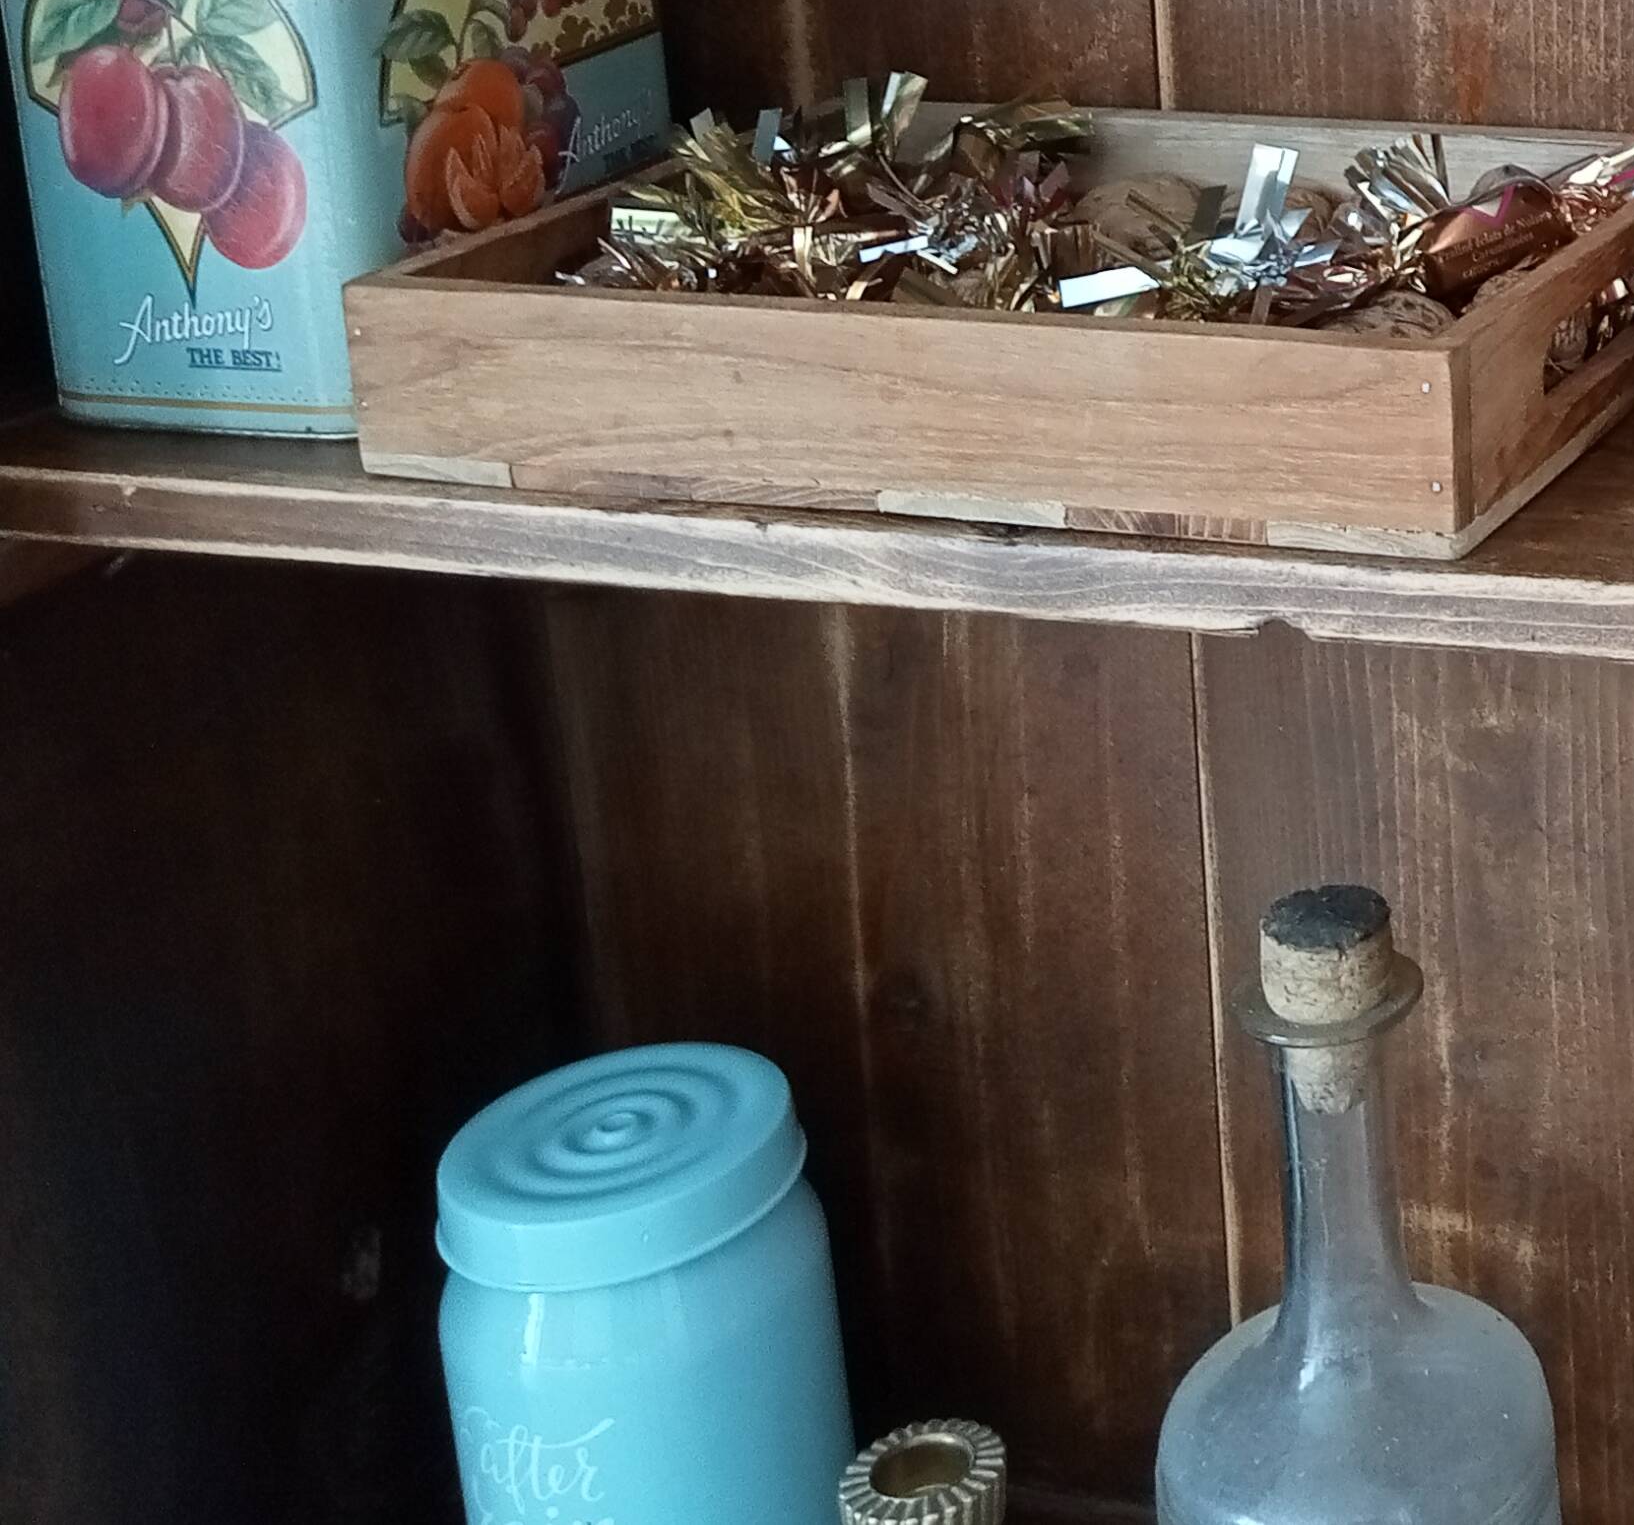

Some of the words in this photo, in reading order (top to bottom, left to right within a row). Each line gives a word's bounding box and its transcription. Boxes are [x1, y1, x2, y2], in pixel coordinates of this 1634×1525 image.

[113, 292, 273, 365] Anthony's
[186, 347, 226, 366] THE
[231, 348, 283, 369] BEST!
